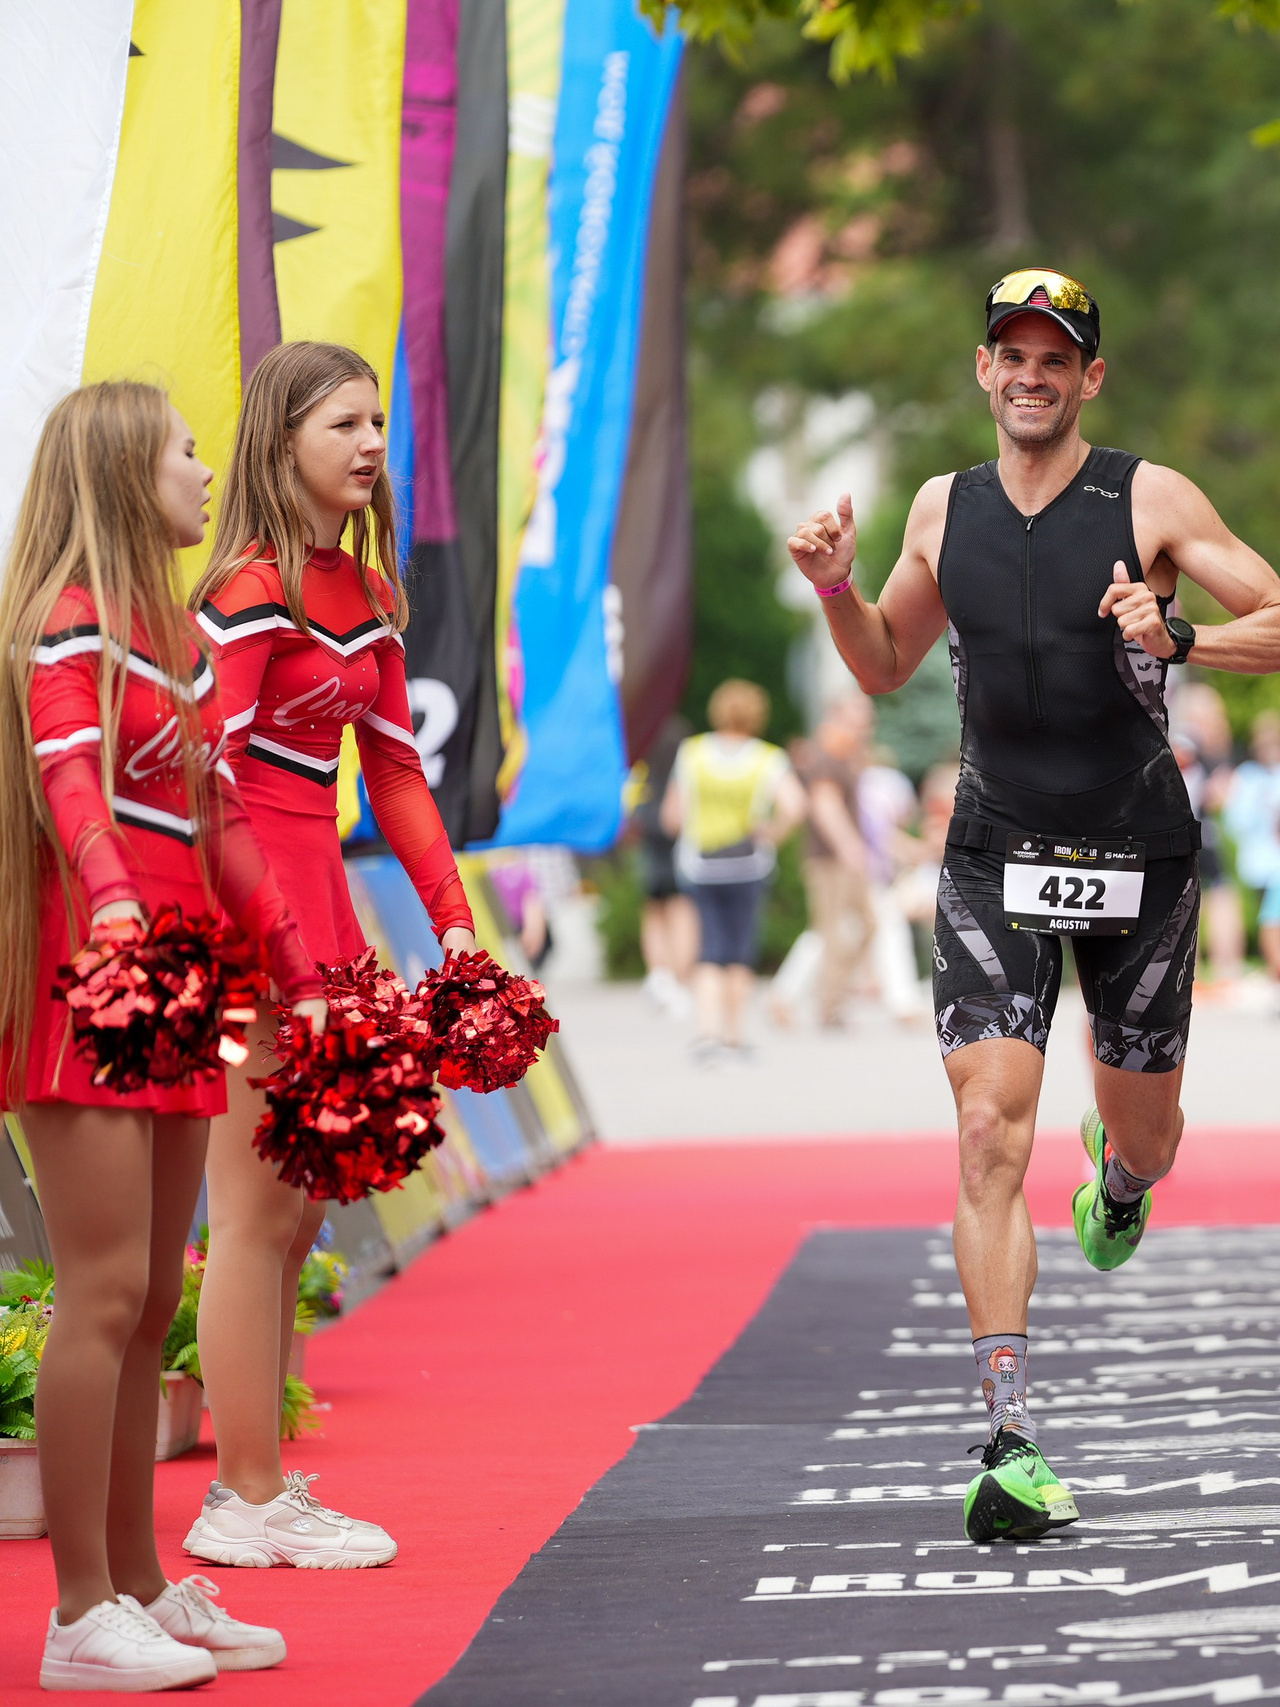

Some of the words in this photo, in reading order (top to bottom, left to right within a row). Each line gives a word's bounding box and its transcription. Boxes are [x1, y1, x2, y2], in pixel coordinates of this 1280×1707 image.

[1083, 485, 1119, 499] orca
[1054, 845, 1072, 855] IRON
[1038, 875, 1107, 910] 422
[1049, 918, 1090, 930] AGUSTIN
[754, 1567, 1127, 1595] IRON
